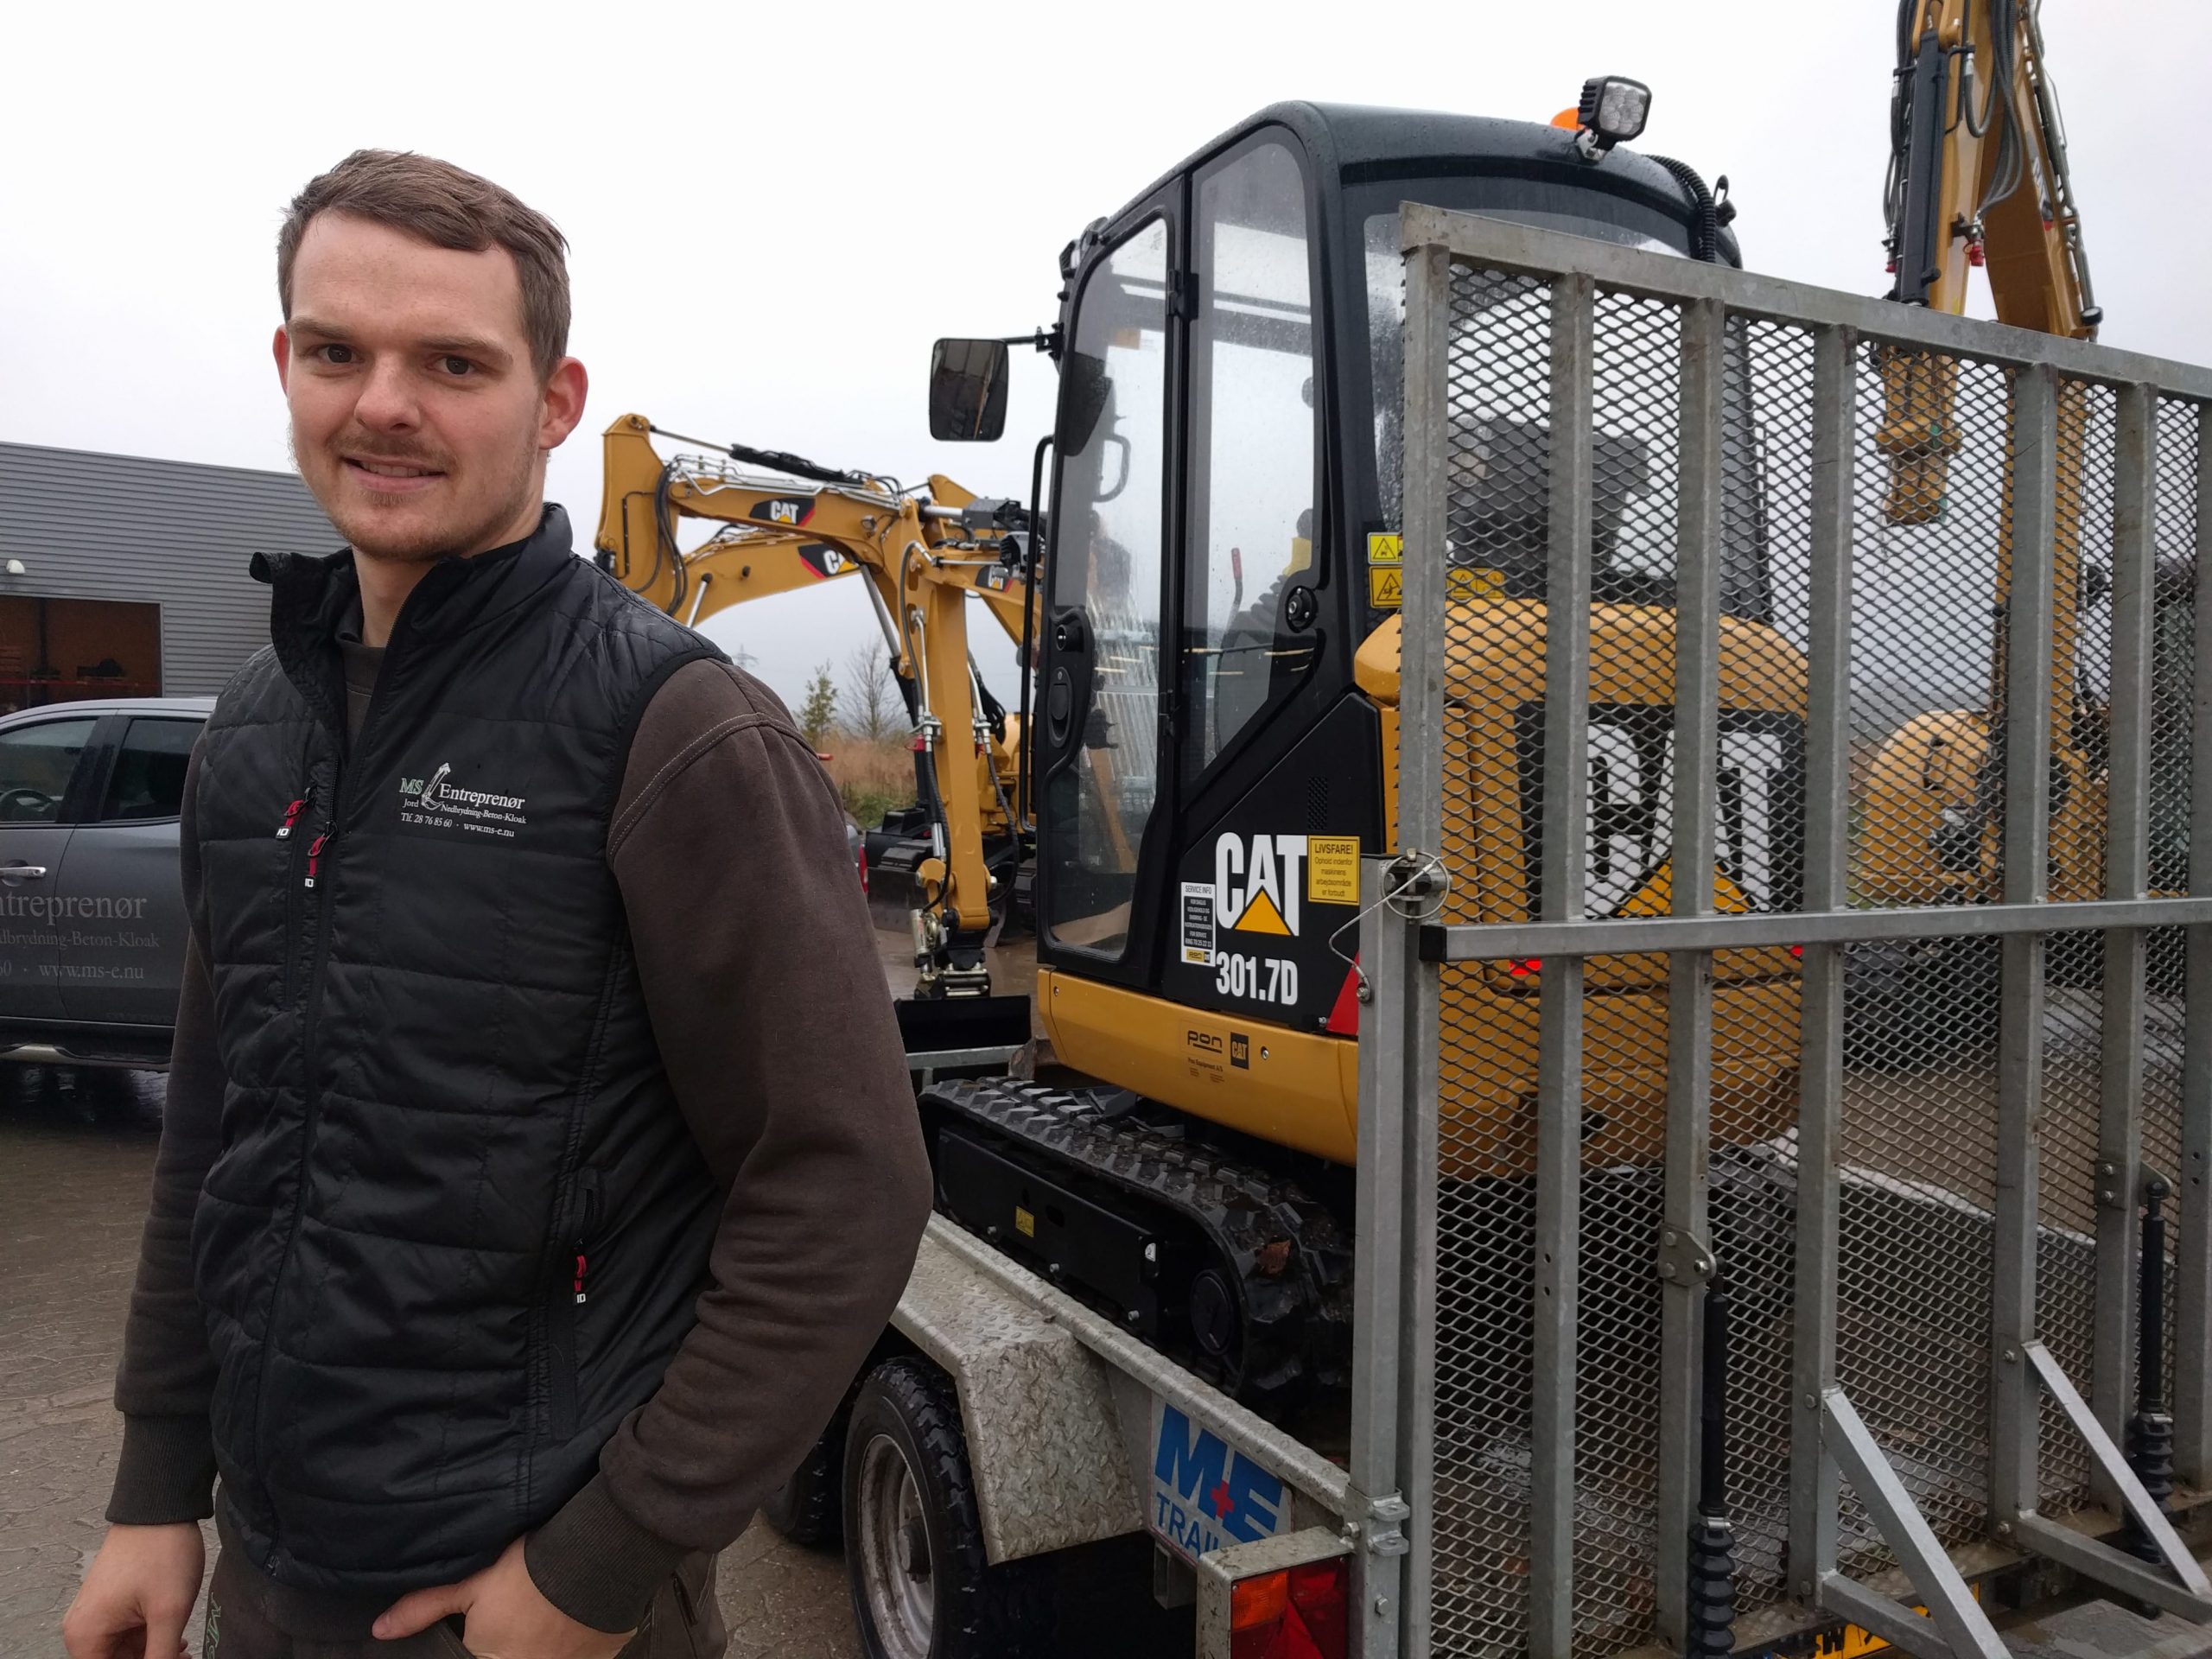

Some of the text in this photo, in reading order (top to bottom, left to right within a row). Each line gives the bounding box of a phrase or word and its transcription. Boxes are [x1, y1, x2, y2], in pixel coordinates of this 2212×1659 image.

[770, 500, 799, 525] CAT
[399, 777, 525, 809] MS Entreprenør
[402, 798, 419, 808] Jord
[414, 814, 423, 823] 28
[424, 816, 433, 825] 76
[434, 817, 443, 826] 85
[443, 818, 453, 828] 60
[463, 823, 515, 837] www.ms-e.nu
[1185, 885, 1212, 894] SERVICE INFO
[1216, 831, 1307, 937] CAT
[1216, 951, 1298, 1006] 301.7D
[1231, 1040, 1248, 1060] CAT
